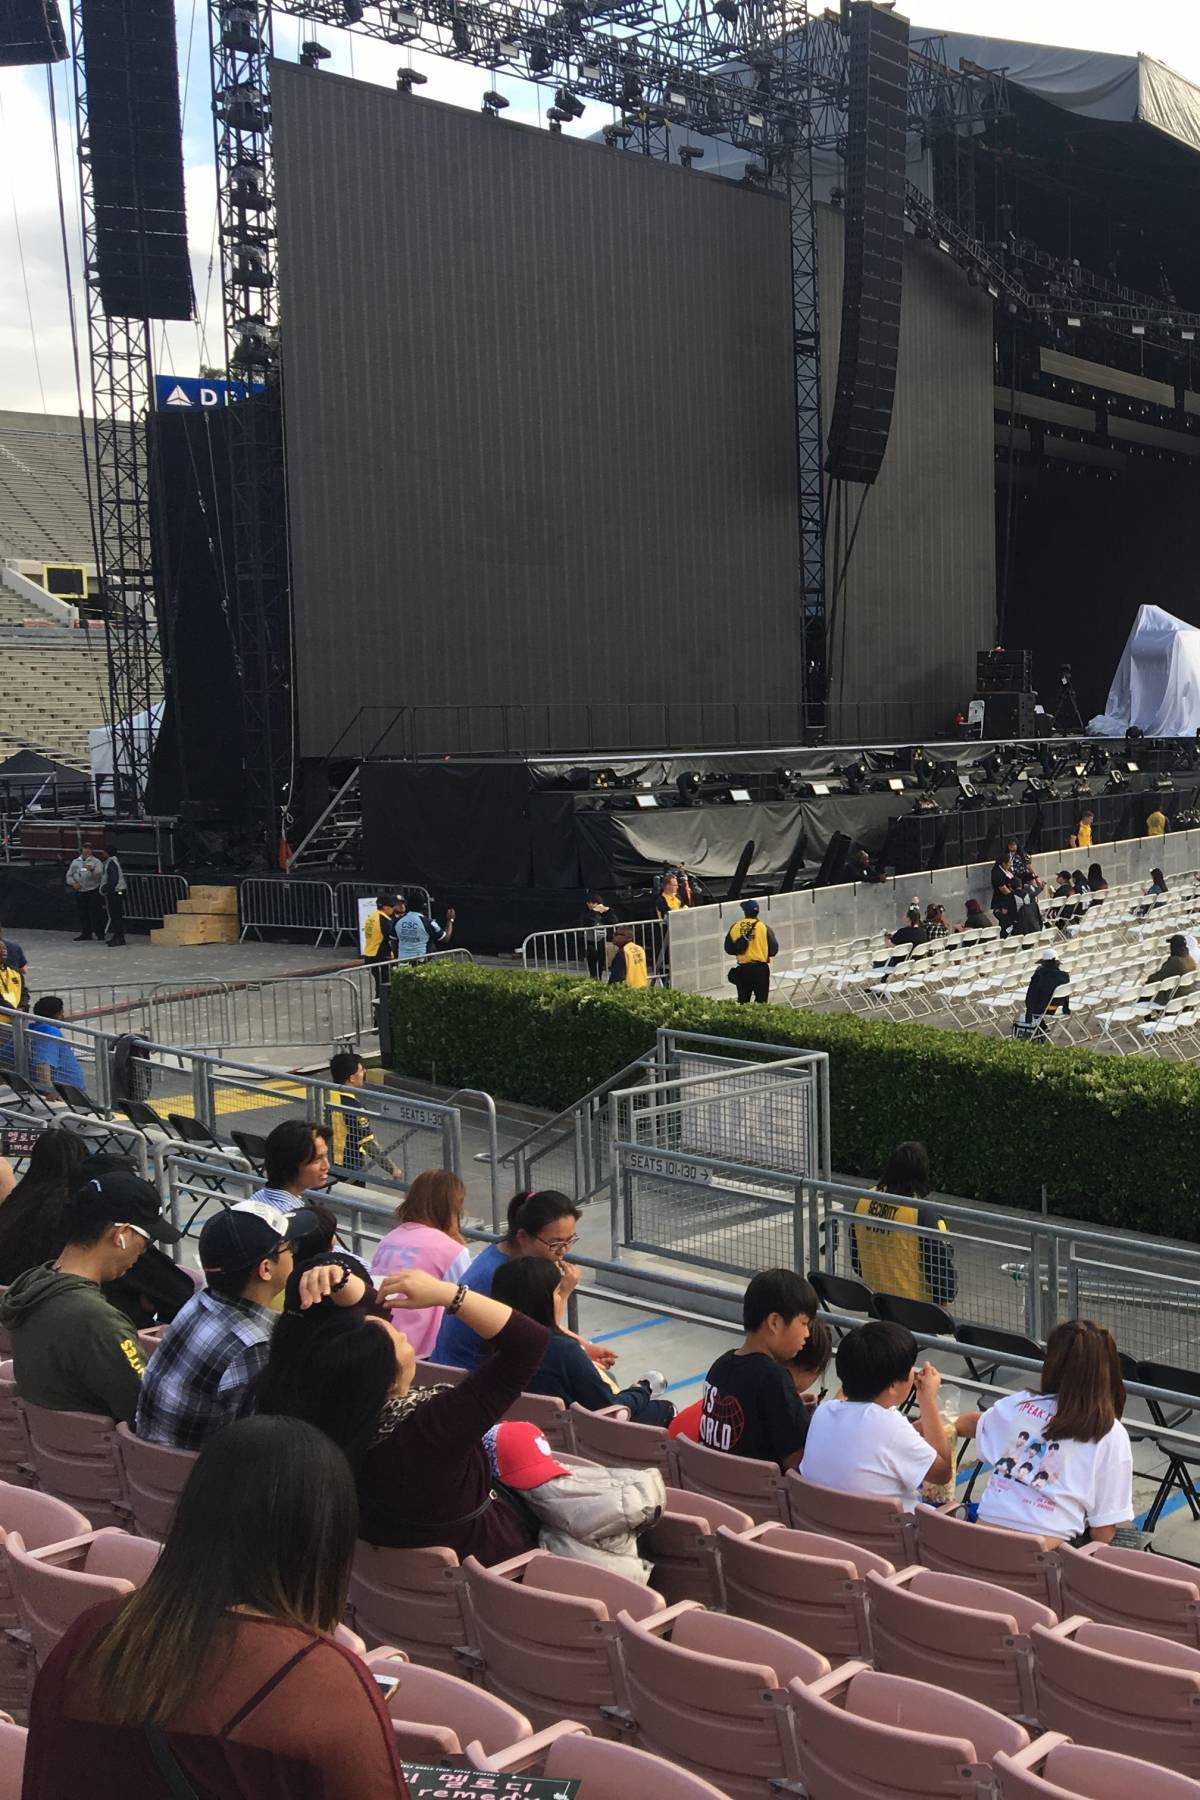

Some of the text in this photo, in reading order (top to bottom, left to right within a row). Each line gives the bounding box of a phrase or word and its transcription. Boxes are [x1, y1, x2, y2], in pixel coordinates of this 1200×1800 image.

[401, 921, 418, 930] CSC
[400, 1106, 425, 1122] SEATS
[630, 1154, 697, 1179] SEATS 101-130
[438, 1773, 533, 1793] 멜로디
